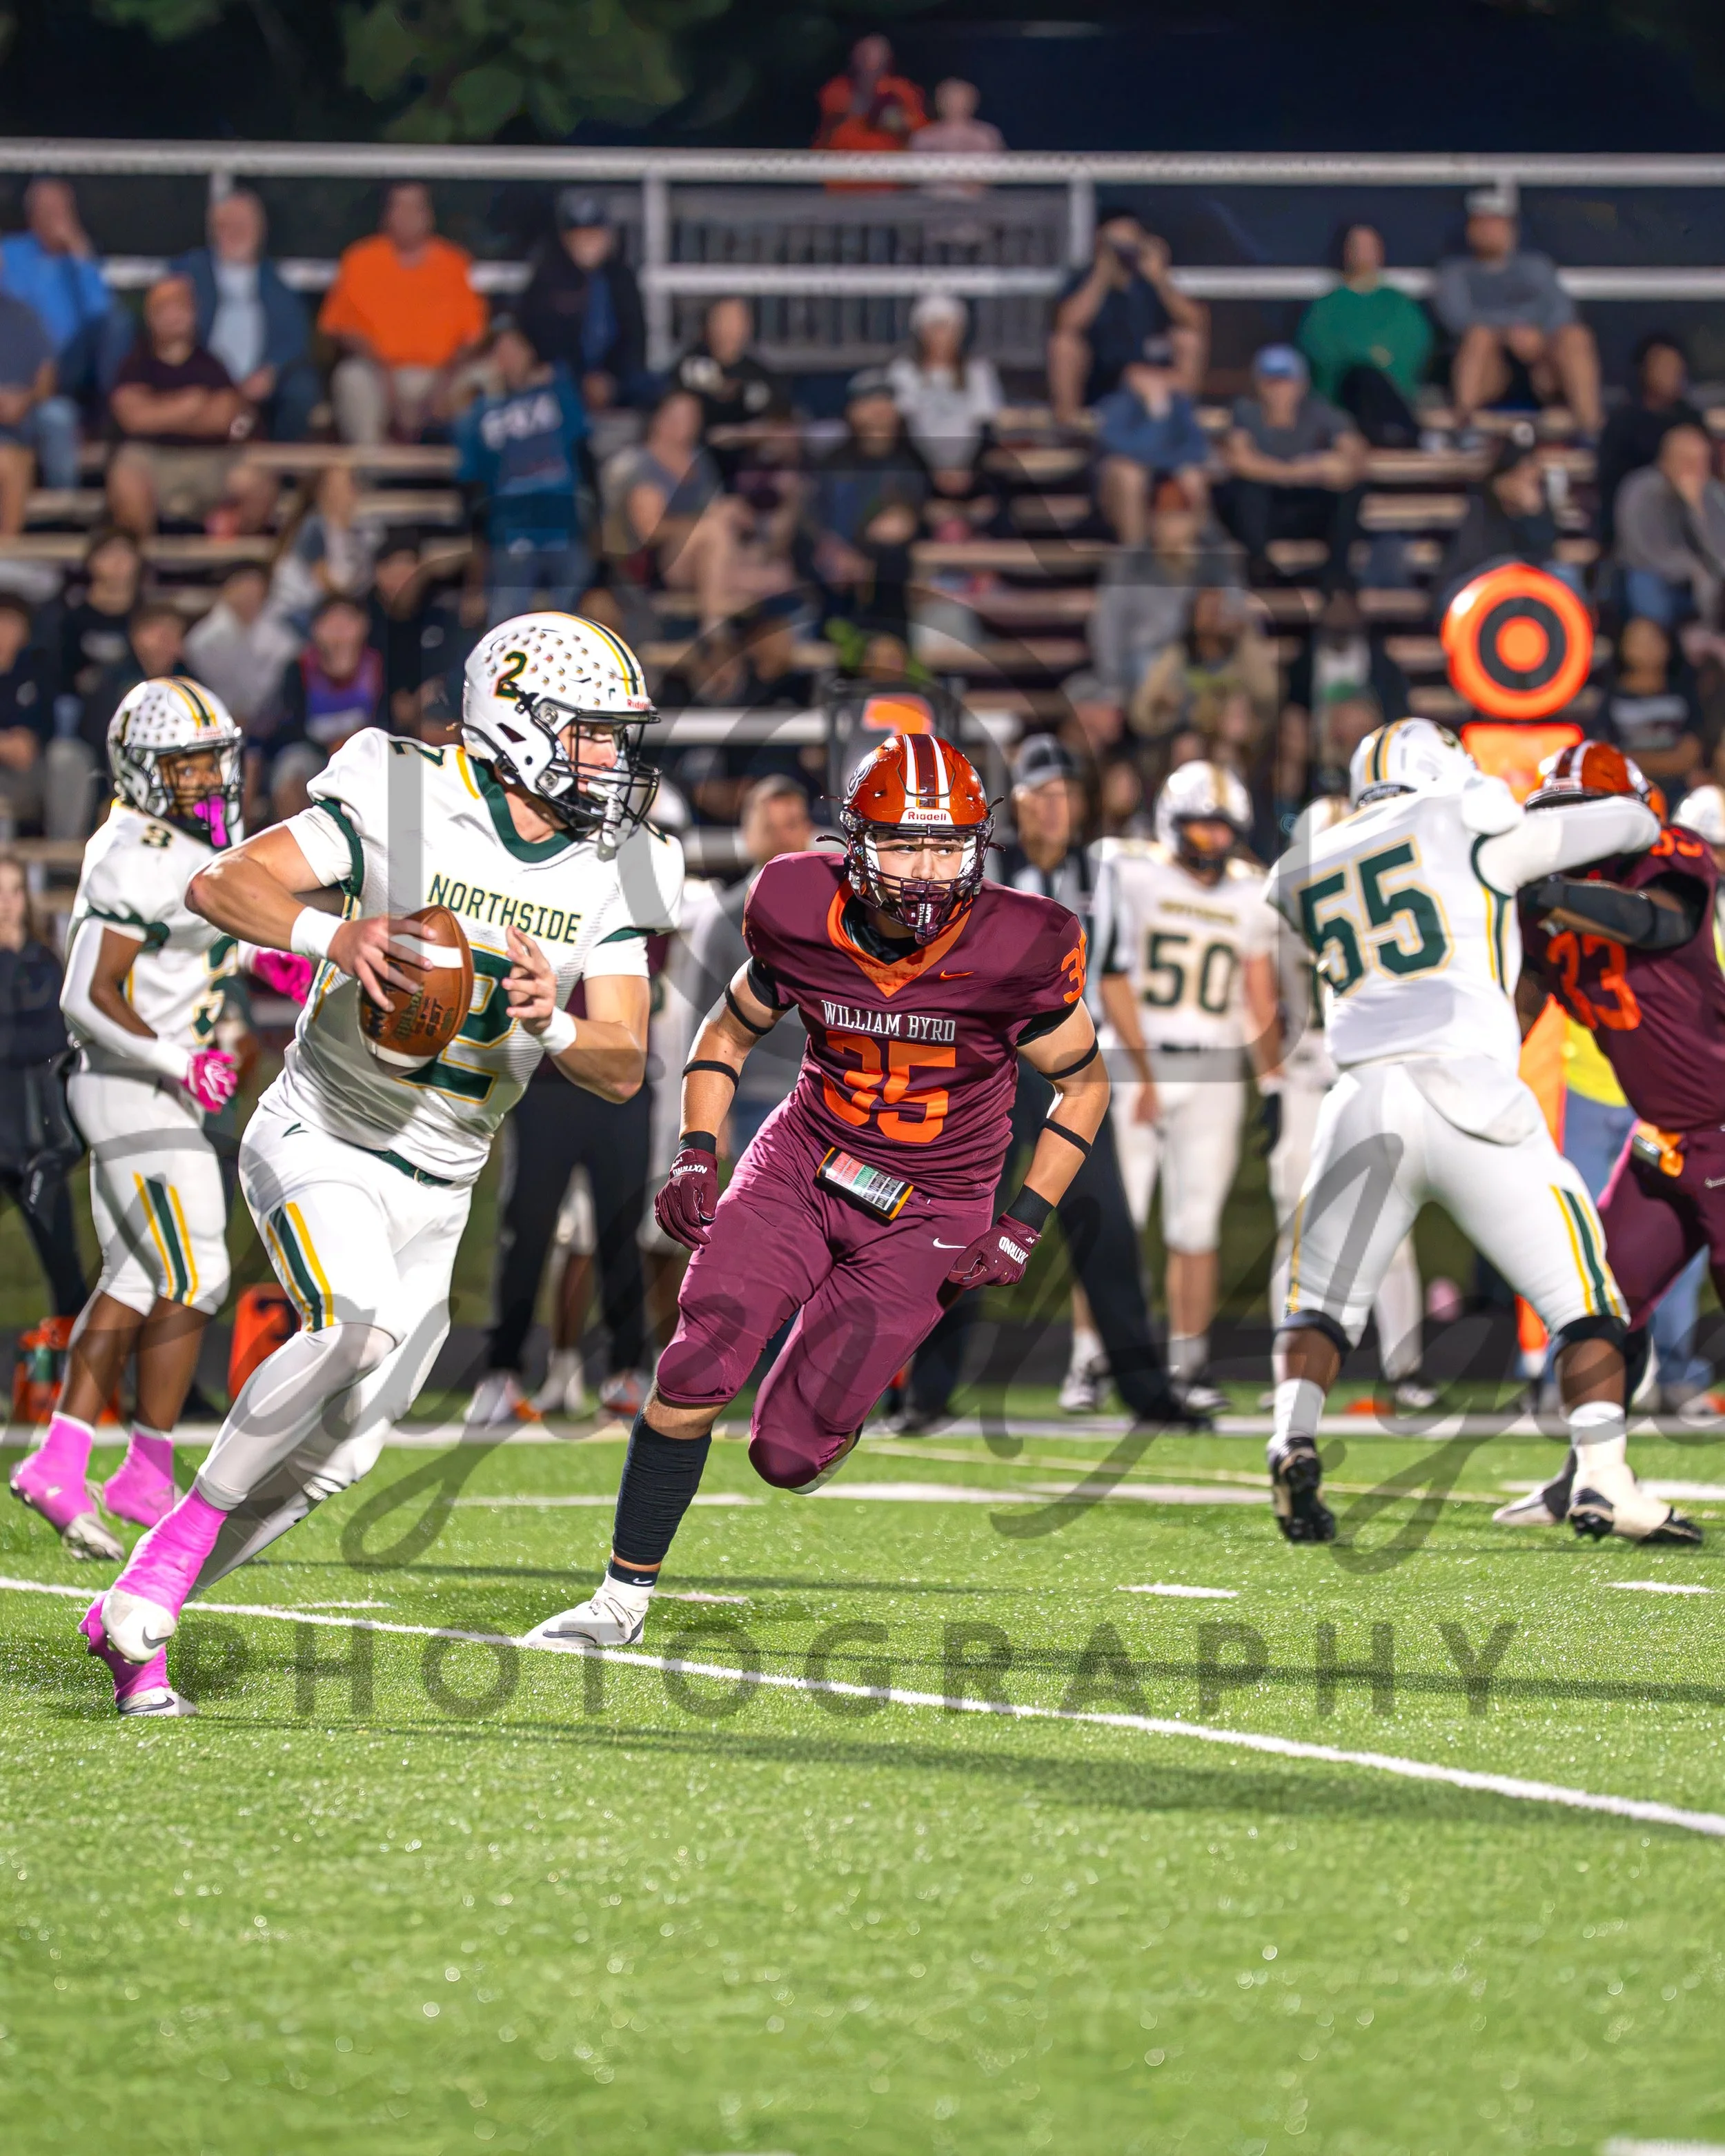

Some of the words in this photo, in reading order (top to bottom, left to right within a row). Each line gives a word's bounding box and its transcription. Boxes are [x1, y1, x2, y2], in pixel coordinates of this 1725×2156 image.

[494, 651, 527, 701] 2
[907, 811, 947, 821] Riddell
[426, 872, 582, 945] NORTHSIDE
[1298, 835, 1455, 998] 55
[1142, 931, 1239, 1016] 50
[820, 999, 902, 1037] WILLIAM
[907, 1015, 956, 1042] BYRD
[823, 1030, 956, 1144] 35
